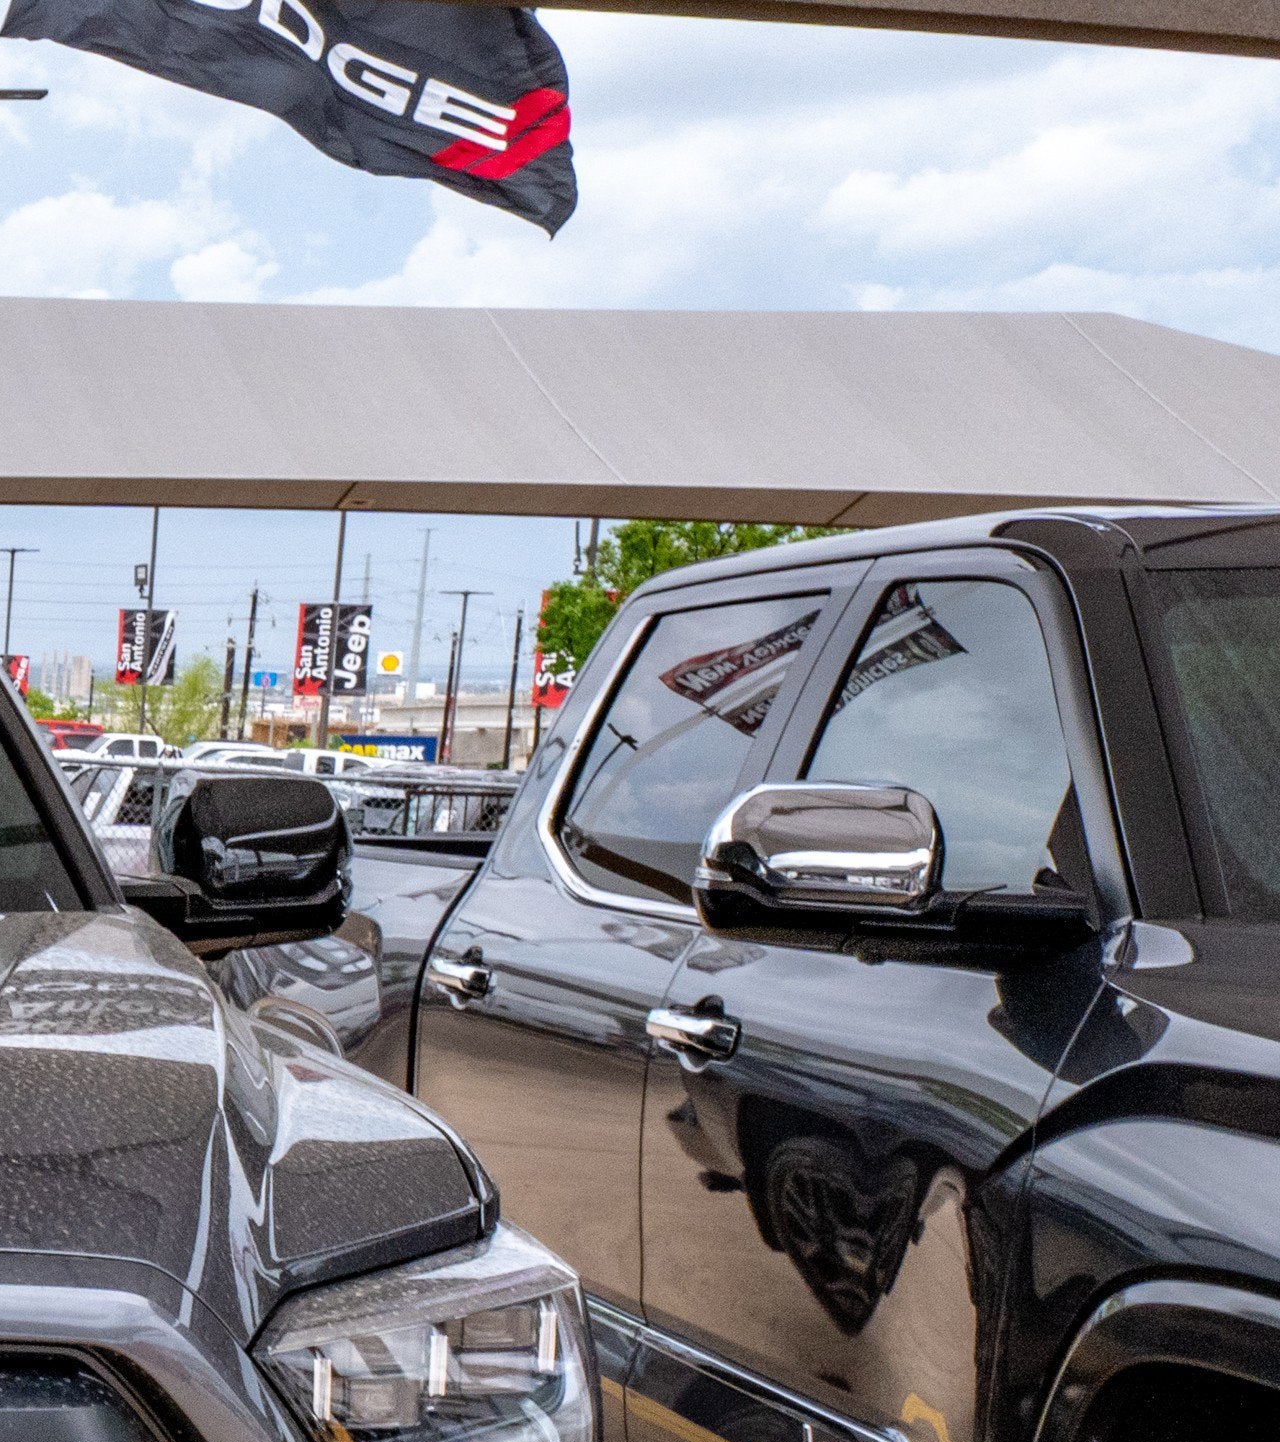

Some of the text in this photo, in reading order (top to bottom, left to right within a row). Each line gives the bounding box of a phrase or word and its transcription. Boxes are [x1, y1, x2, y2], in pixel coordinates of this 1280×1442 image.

[190, 0, 517, 151] DGE
[118, 643, 132, 671] San
[131, 612, 146, 672] Antonio
[295, 645, 313, 680] San
[312, 607, 333, 680] Antonio
[333, 614, 371, 689] Jeep
